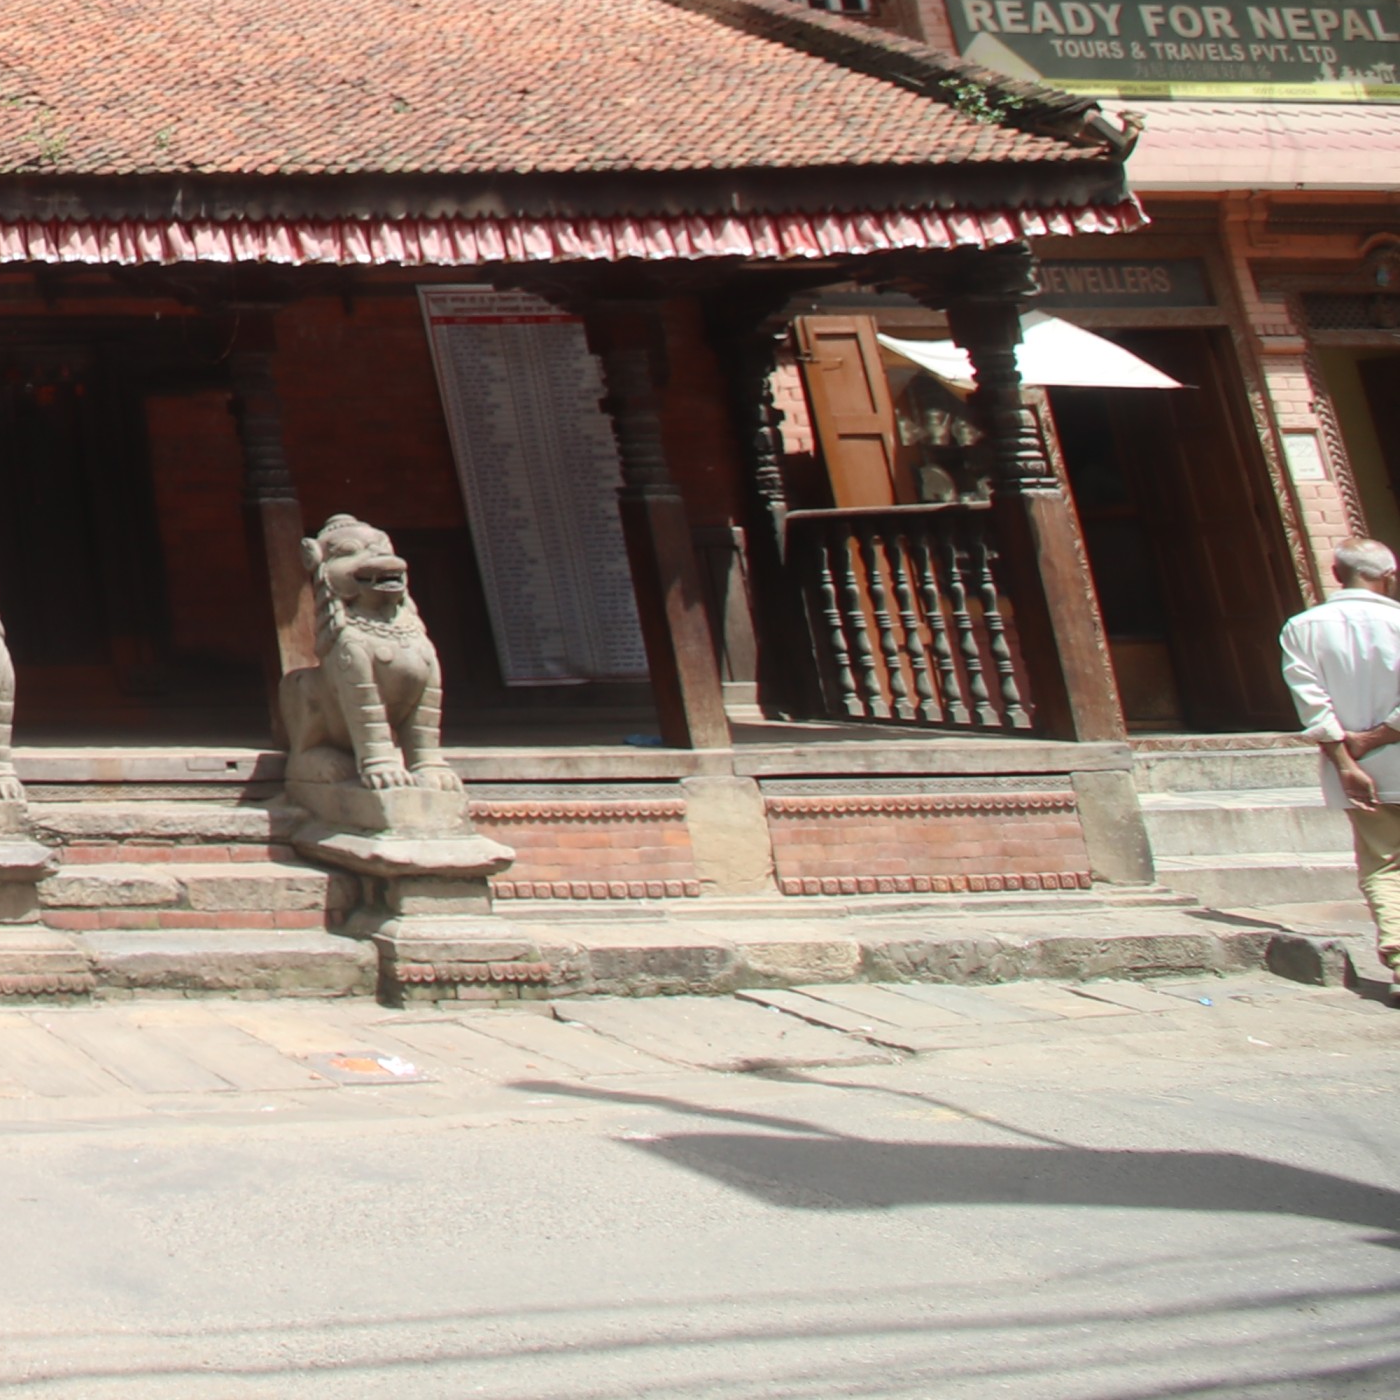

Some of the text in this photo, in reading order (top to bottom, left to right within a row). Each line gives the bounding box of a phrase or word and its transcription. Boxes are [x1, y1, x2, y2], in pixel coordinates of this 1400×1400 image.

[961, 0, 1400, 41] READY FOR NEPAL
[1051, 39, 1338, 64] TOURS & TRAVELS PVT. LTD
[1039, 266, 1171, 293] JEWELLERS
